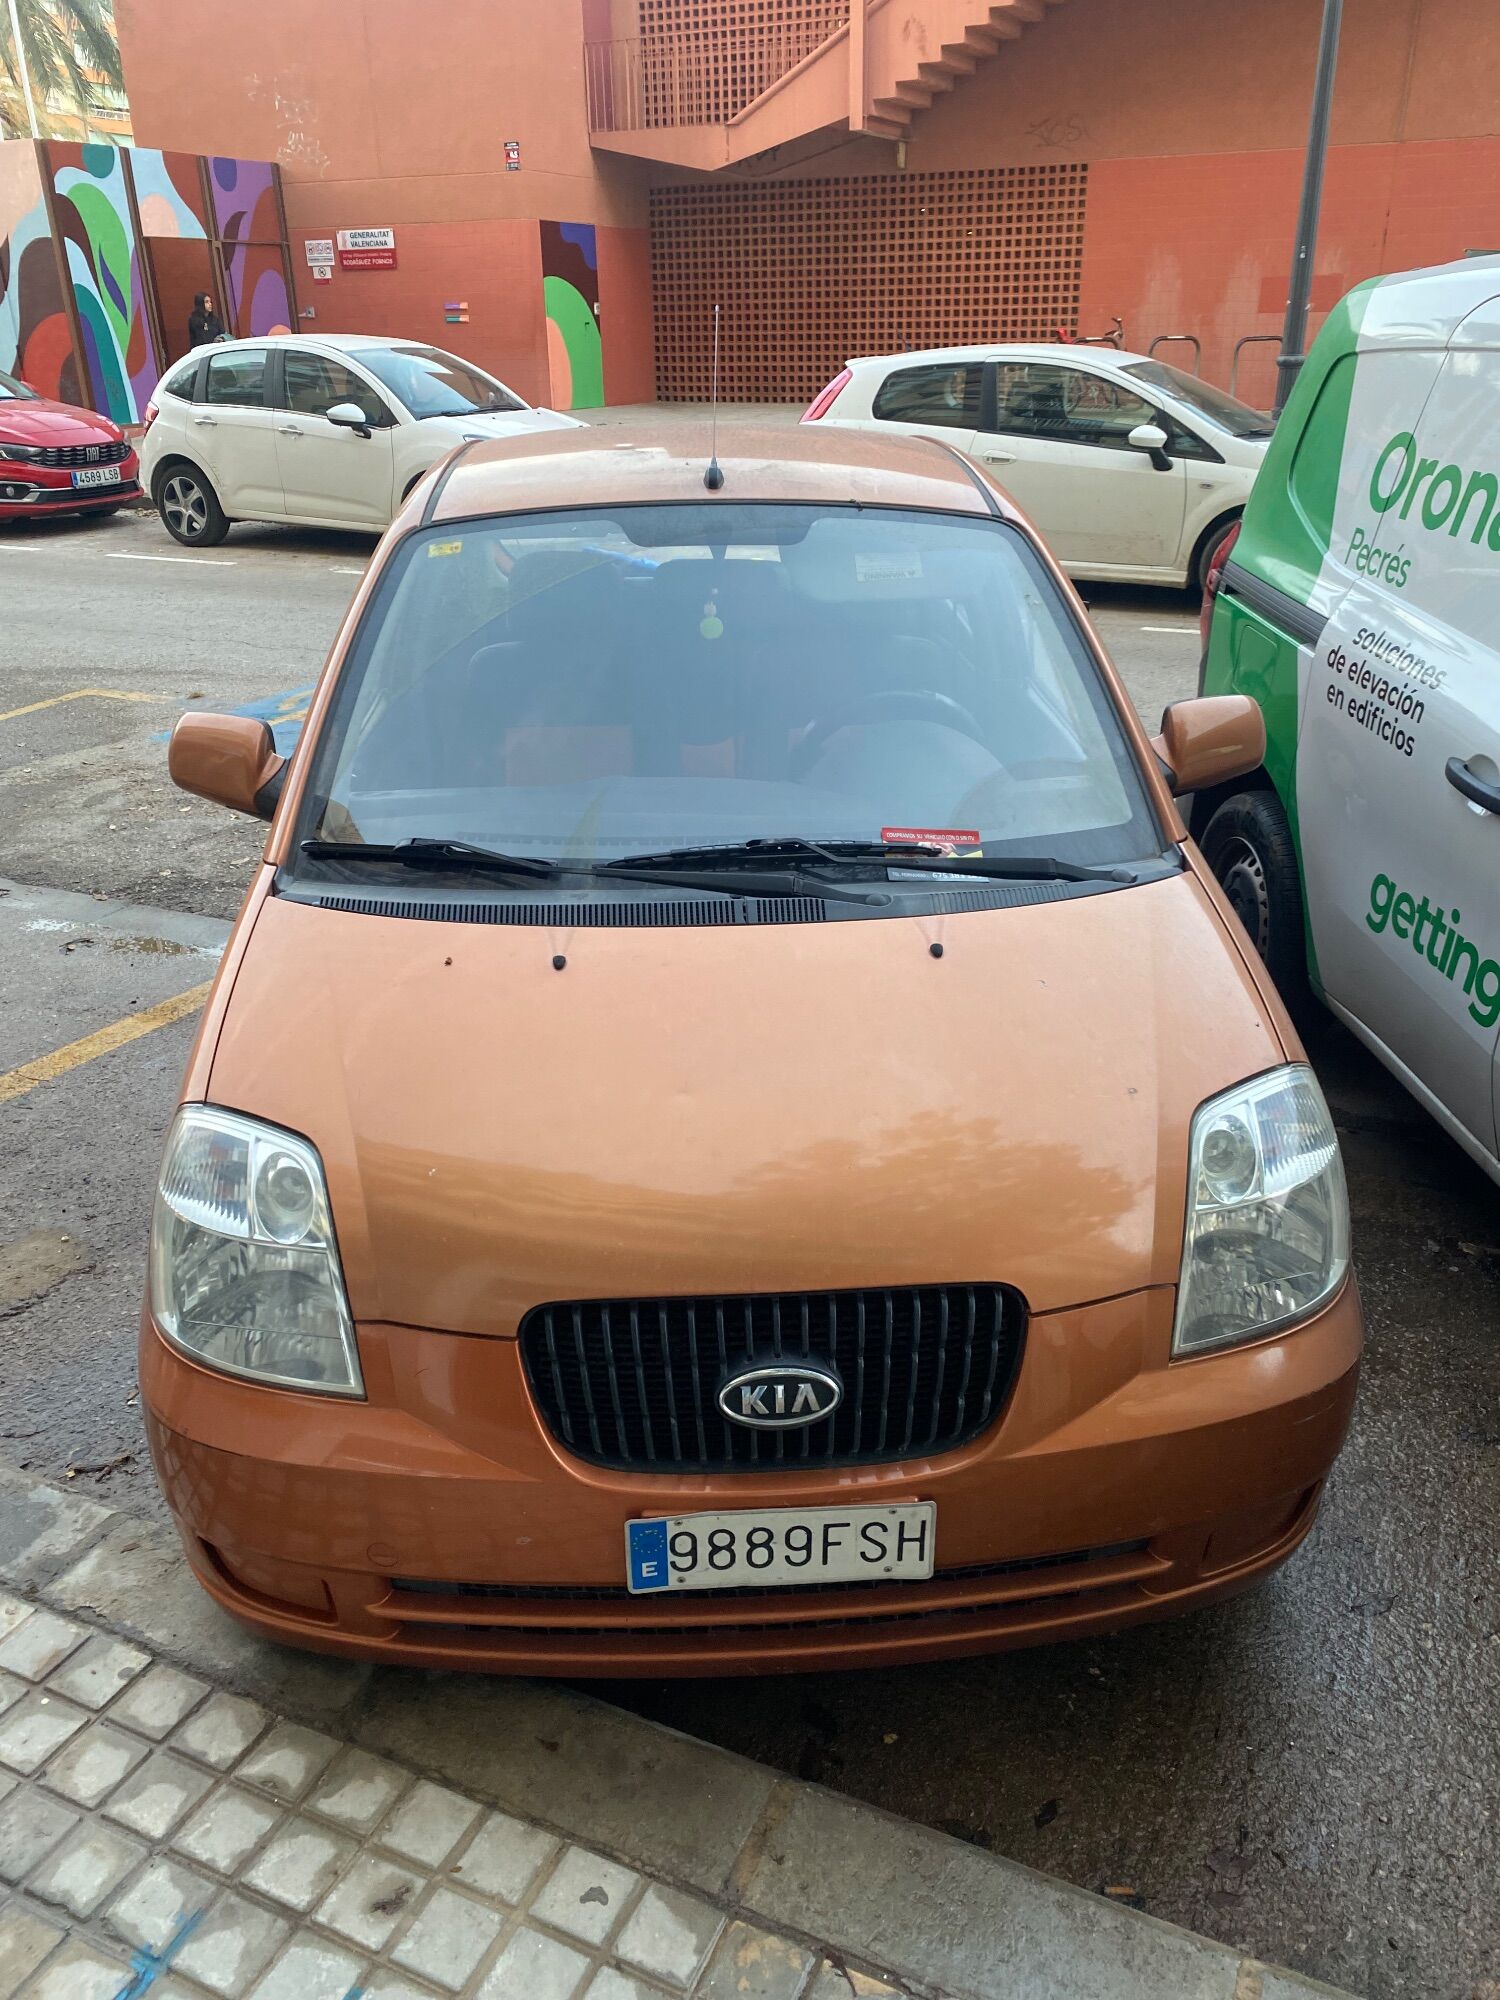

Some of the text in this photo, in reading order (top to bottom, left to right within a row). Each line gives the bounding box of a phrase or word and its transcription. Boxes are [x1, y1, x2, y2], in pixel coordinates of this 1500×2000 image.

[350, 231, 389, 239] GENERALITAT
[79, 472, 102, 483] 4589
[103, 469, 119, 480] LSB
[86, 447, 100, 461] FIAT
[1344, 527, 1412, 588] Pecrés
[1327, 644, 1425, 724] de elevación
[1352, 627, 1448, 690] soluciones
[1326, 683, 1416, 757] en edificios
[1365, 873, 1500, 1028] getting
[739, 1383, 821, 1415] KIA
[641, 1561, 658, 1578] E
[668, 1519, 927, 1573] 9889FSH
